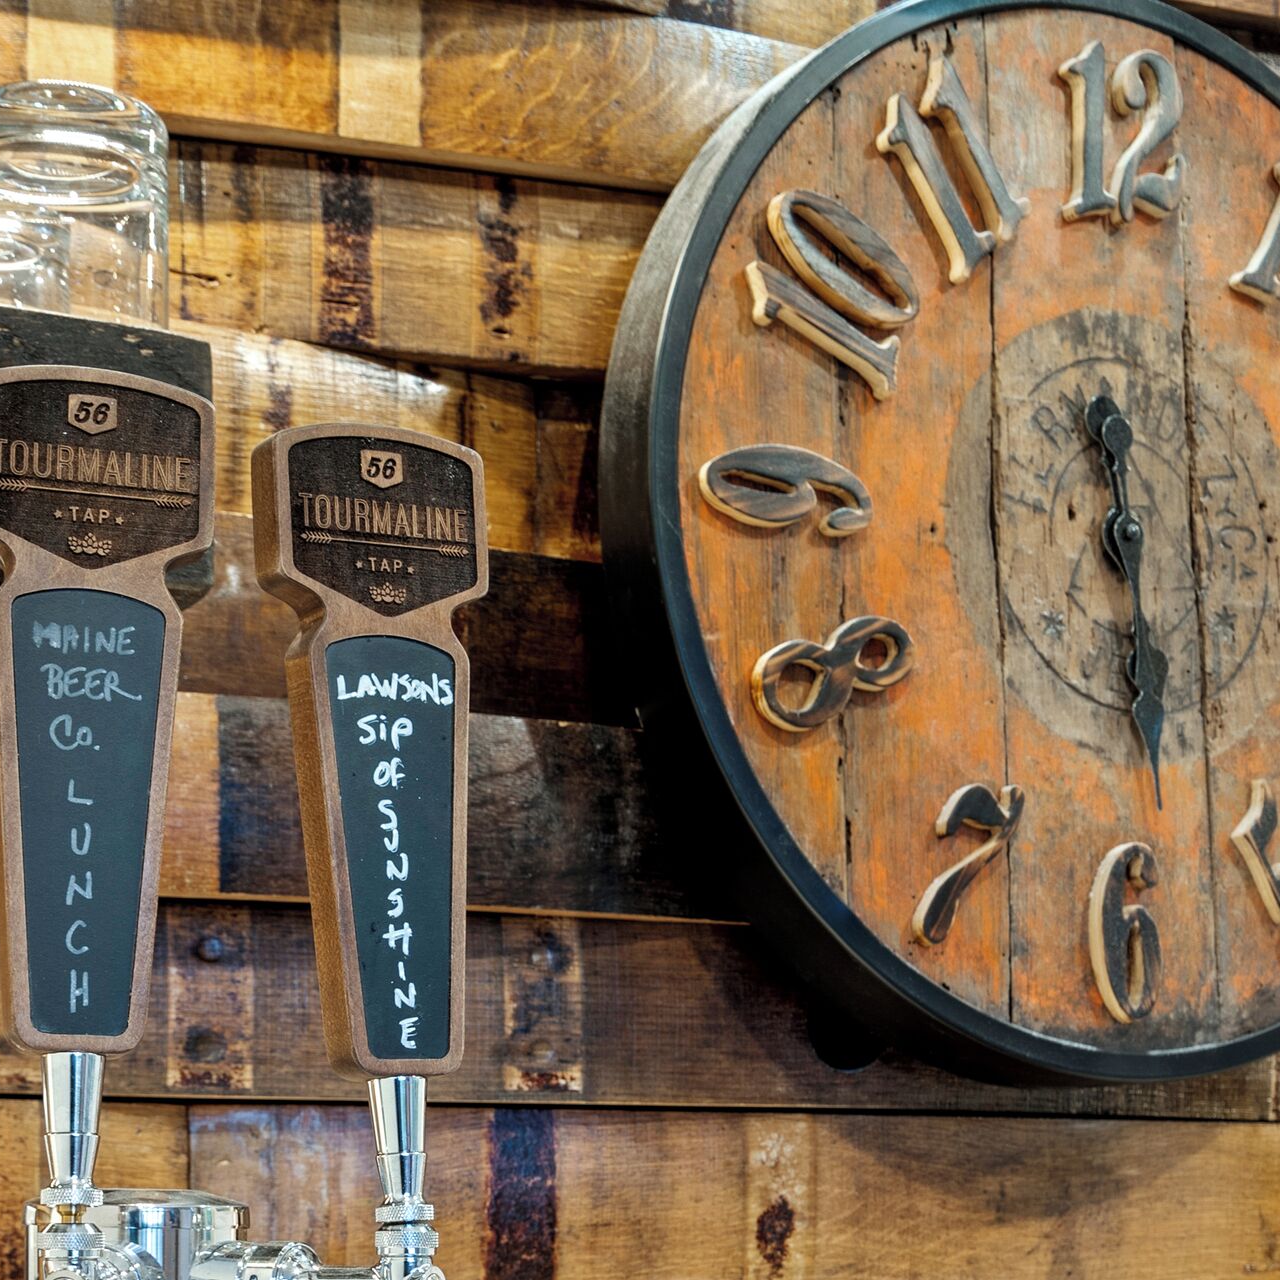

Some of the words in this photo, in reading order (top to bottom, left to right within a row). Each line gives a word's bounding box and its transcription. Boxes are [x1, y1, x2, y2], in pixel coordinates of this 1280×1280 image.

[876, 52, 1031, 285] 11
[1056, 40, 1185, 225] 12
[745, 189, 920, 400] 10
[73, 400, 111, 426] 56
[69, 505, 111, 524] TAP
[298, 492, 468, 543] TOURMALINE
[366, 457, 397, 480] 56
[699, 444, 873, 538] 9
[368, 556, 403, 574] TAP
[32, 621, 136, 656] MAINE
[40, 664, 142, 702] BEER
[752, 615, 914, 733] 8
[64, 778, 94, 1014] LUNCH
[912, 783, 1025, 947] 7
[376, 799, 419, 1050] SUNSHINE
[1087, 841, 1162, 1026] 6
